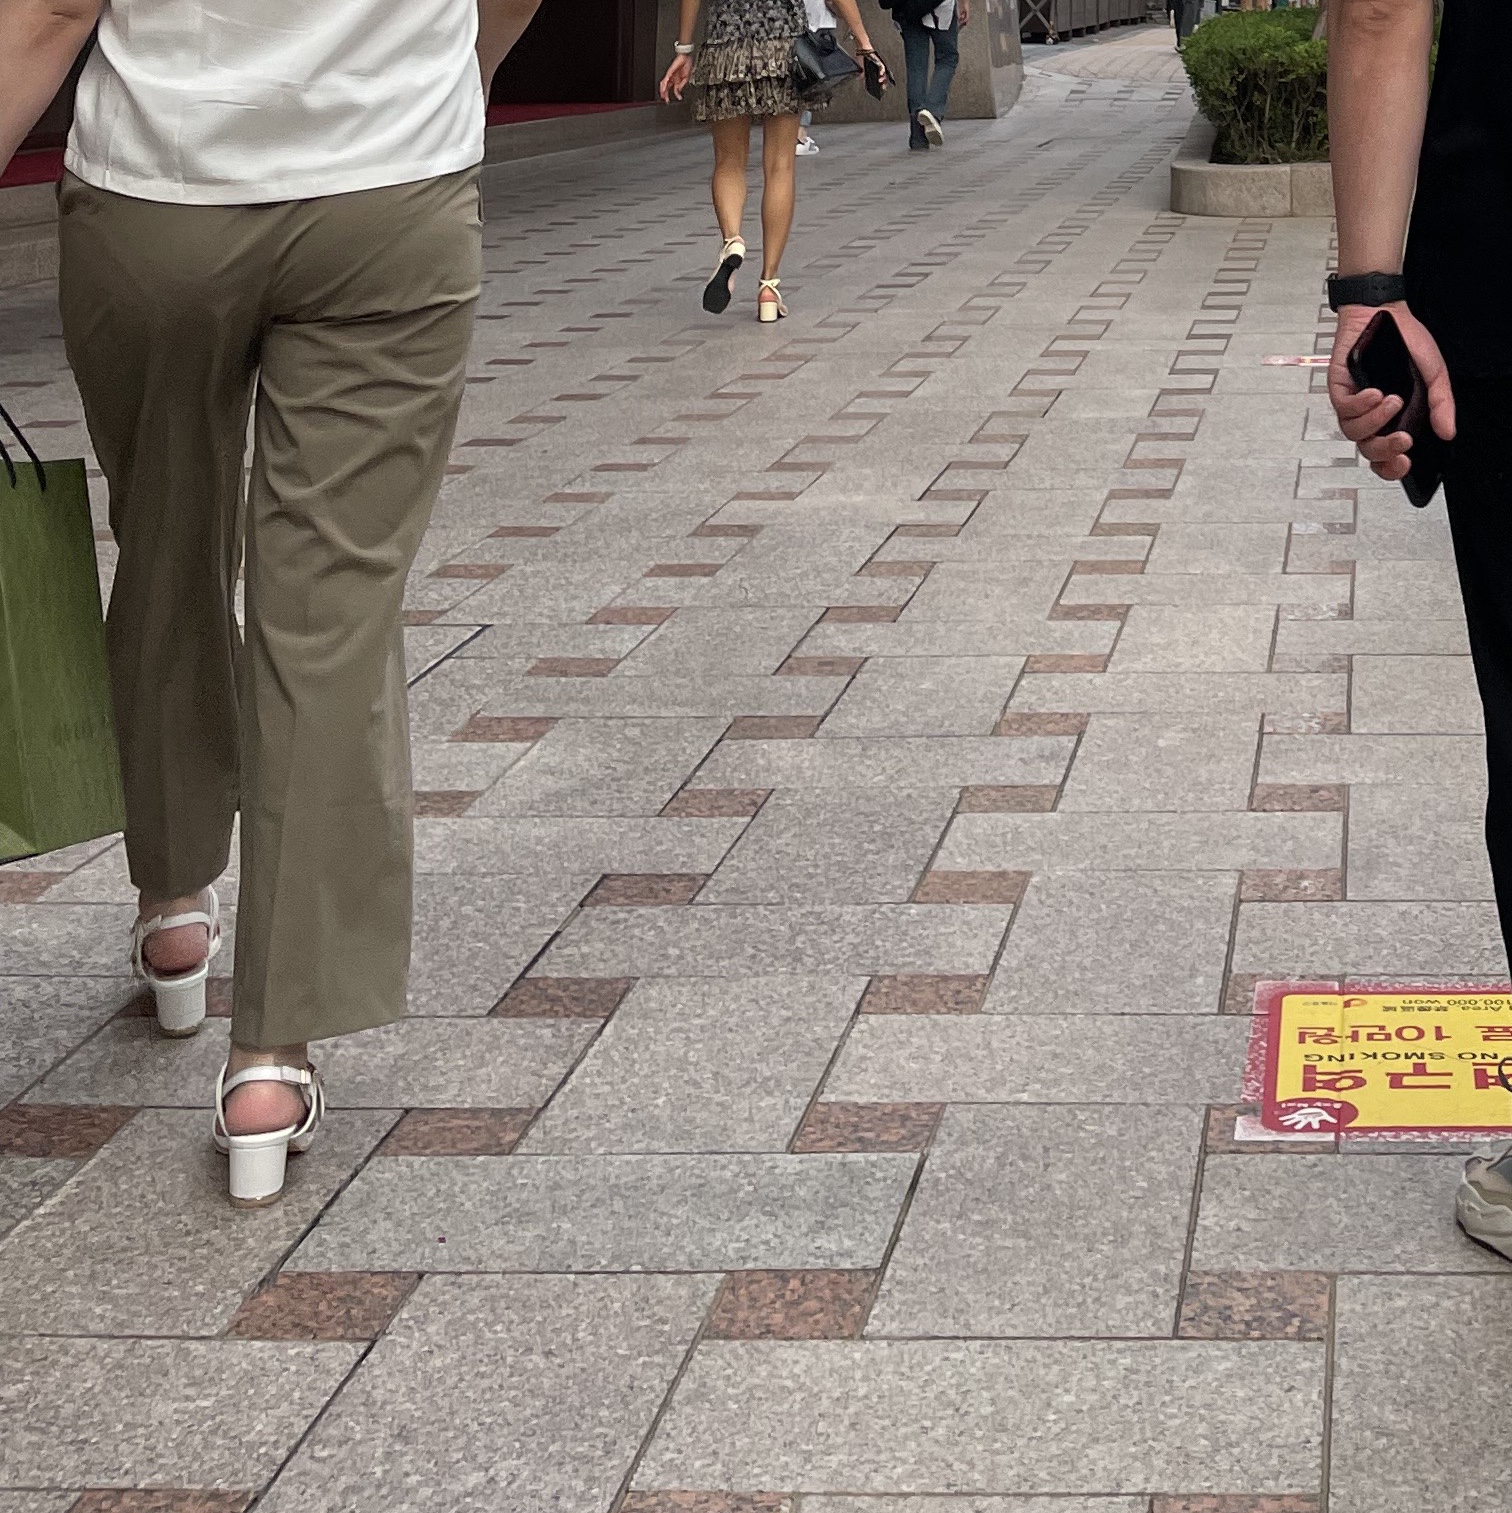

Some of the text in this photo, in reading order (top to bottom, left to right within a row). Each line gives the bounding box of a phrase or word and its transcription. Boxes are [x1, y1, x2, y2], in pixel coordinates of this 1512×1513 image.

[1297, 1024, 1452, 1045] 10만원
[1304, 1052, 1499, 1062] NO SMOKING
